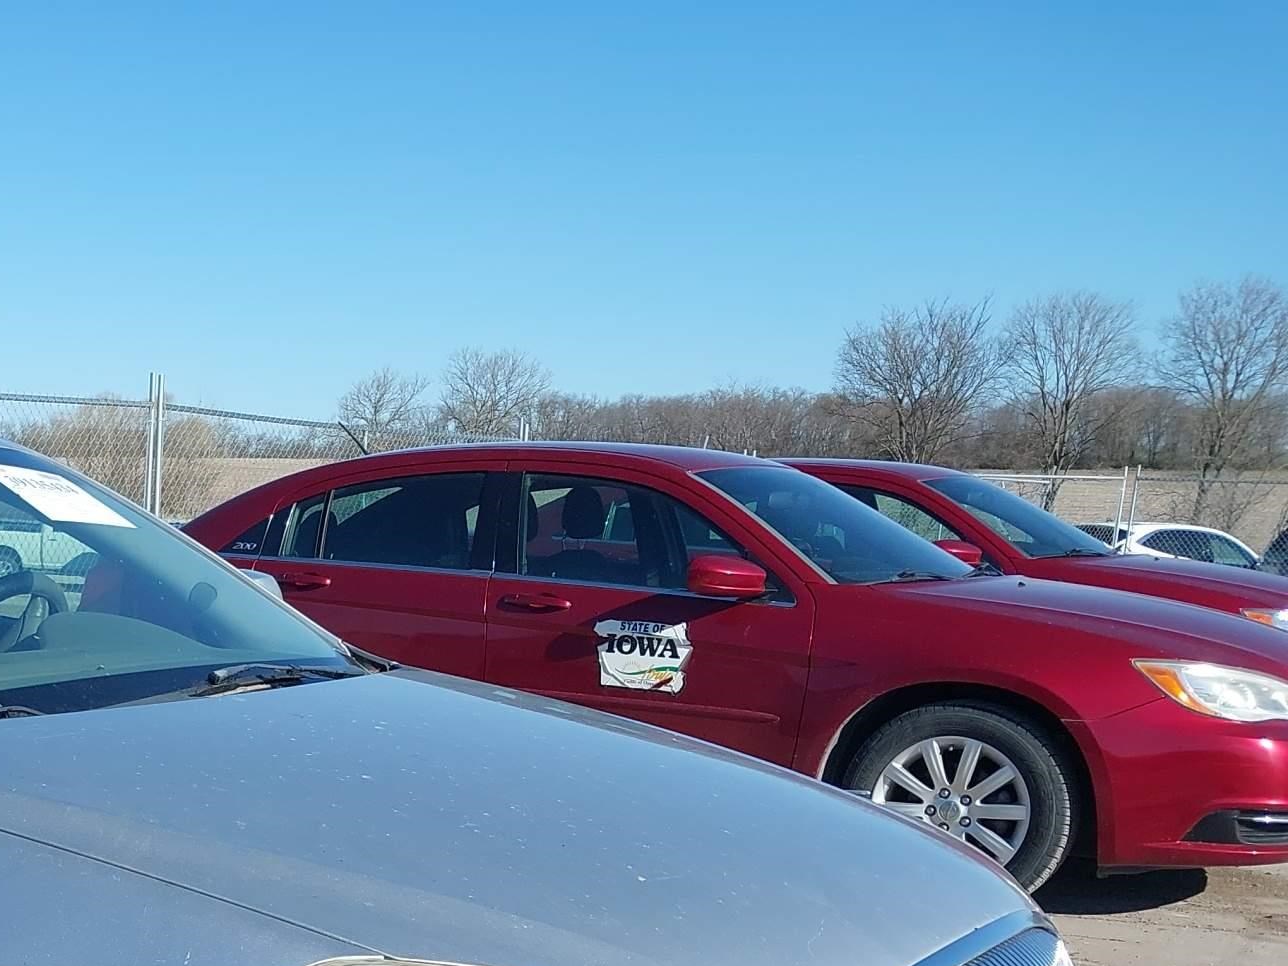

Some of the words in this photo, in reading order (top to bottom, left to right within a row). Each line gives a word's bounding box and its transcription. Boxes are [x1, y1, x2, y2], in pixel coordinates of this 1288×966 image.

[231, 541, 258, 550] 200
[620, 621, 650, 633] STATE
[652, 624, 666, 634] OF
[605, 633, 680, 659] IOWA
